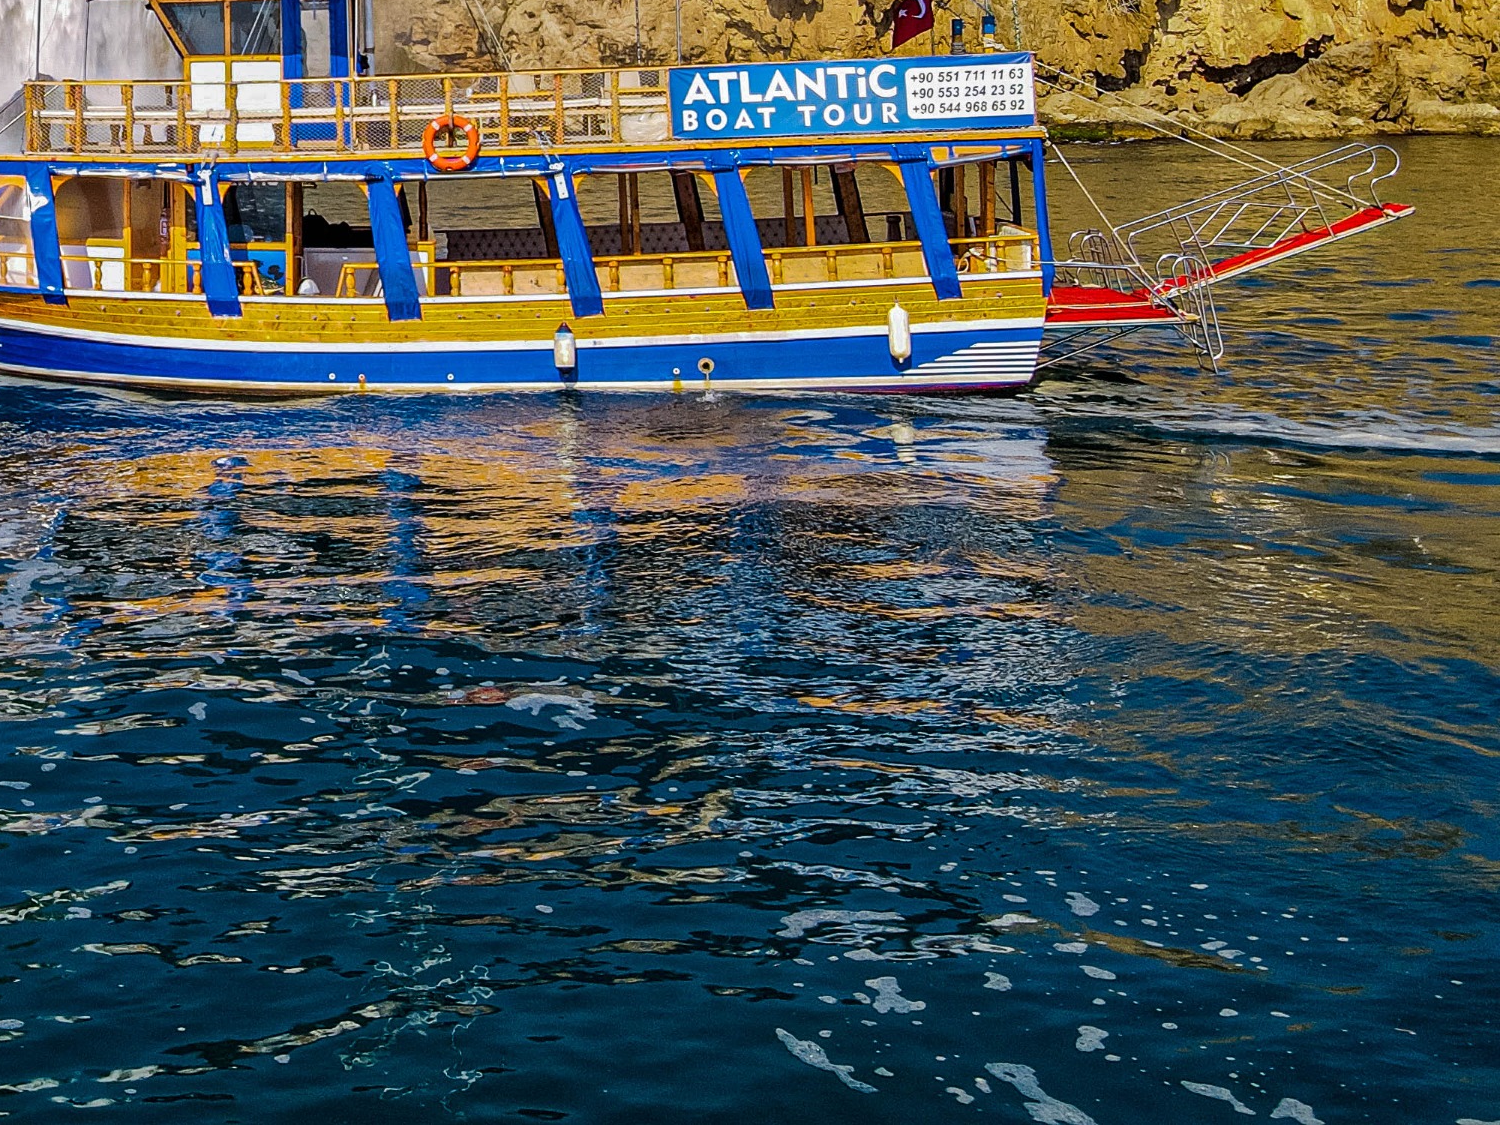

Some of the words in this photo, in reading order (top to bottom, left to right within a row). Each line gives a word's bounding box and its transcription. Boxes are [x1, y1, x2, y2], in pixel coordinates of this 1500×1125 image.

[910, 72, 933, 83] +90
[937, 71, 960, 82] 551
[964, 70, 986, 81] 711
[991, 69, 1004, 80] 11
[1008, 68, 1024, 79] 63
[911, 88, 934, 99] +90
[937, 86, 960, 98] 553
[964, 85, 986, 97] 254
[991, 85, 1005, 96] 23
[1009, 83, 1024, 95] 52
[912, 103, 935, 115] +90
[939, 102, 961, 113] 544
[965, 101, 988, 113] 968
[991, 100, 1007, 111] 65
[1010, 99, 1025, 111] 92
[682, 107, 776, 132] BOAT
[797, 102, 900, 128] TOUR
